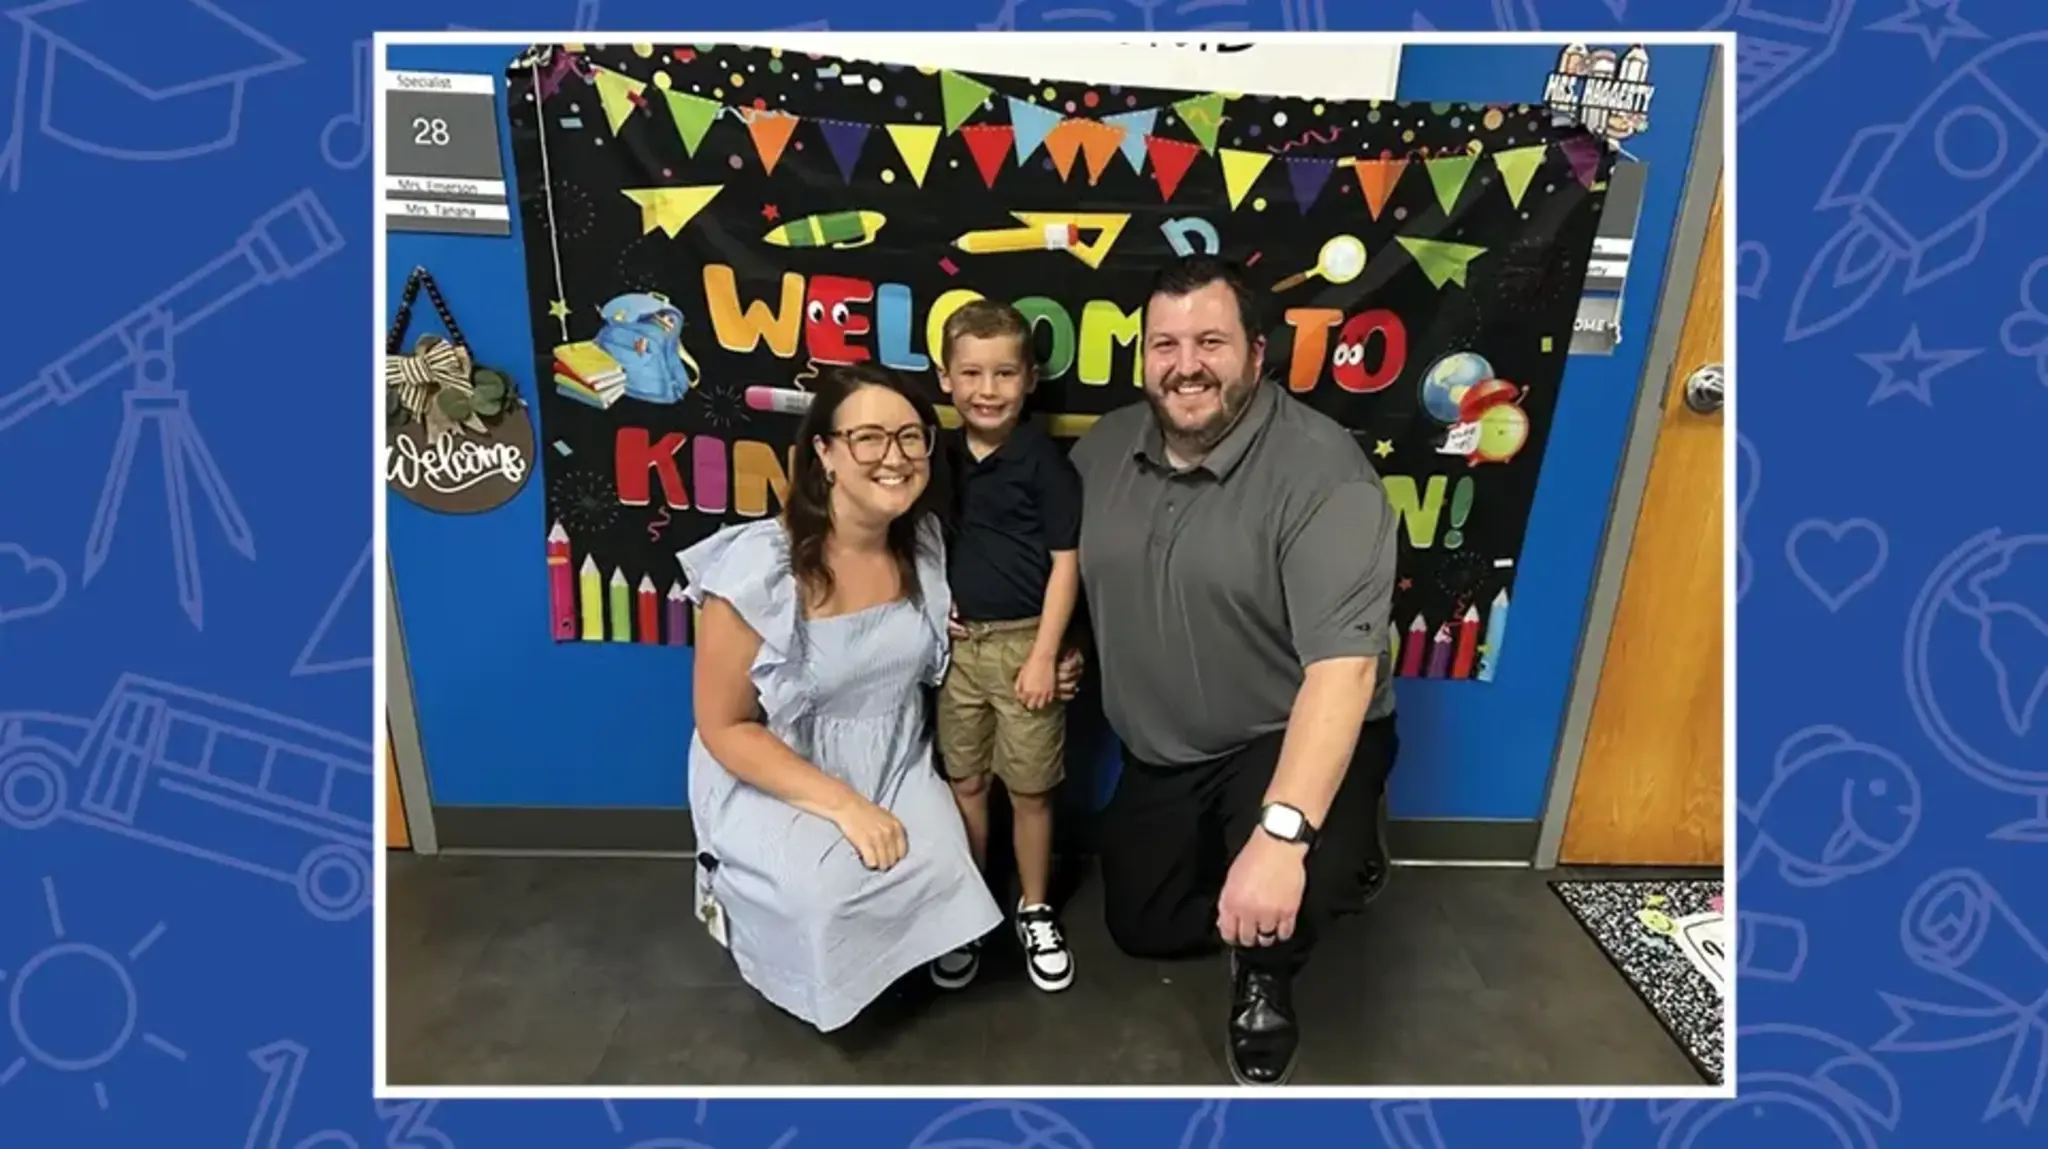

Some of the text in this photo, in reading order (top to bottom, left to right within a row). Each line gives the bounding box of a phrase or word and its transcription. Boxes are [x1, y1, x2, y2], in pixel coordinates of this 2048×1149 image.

[396, 74, 452, 89] Specialist
[412, 117, 450, 146] 28
[398, 179, 421, 191] Mrs.
[405, 203, 429, 215] Mrs.
[702, 263, 1407, 393] WELCOM TO
[386, 432, 526, 494] Welcome
